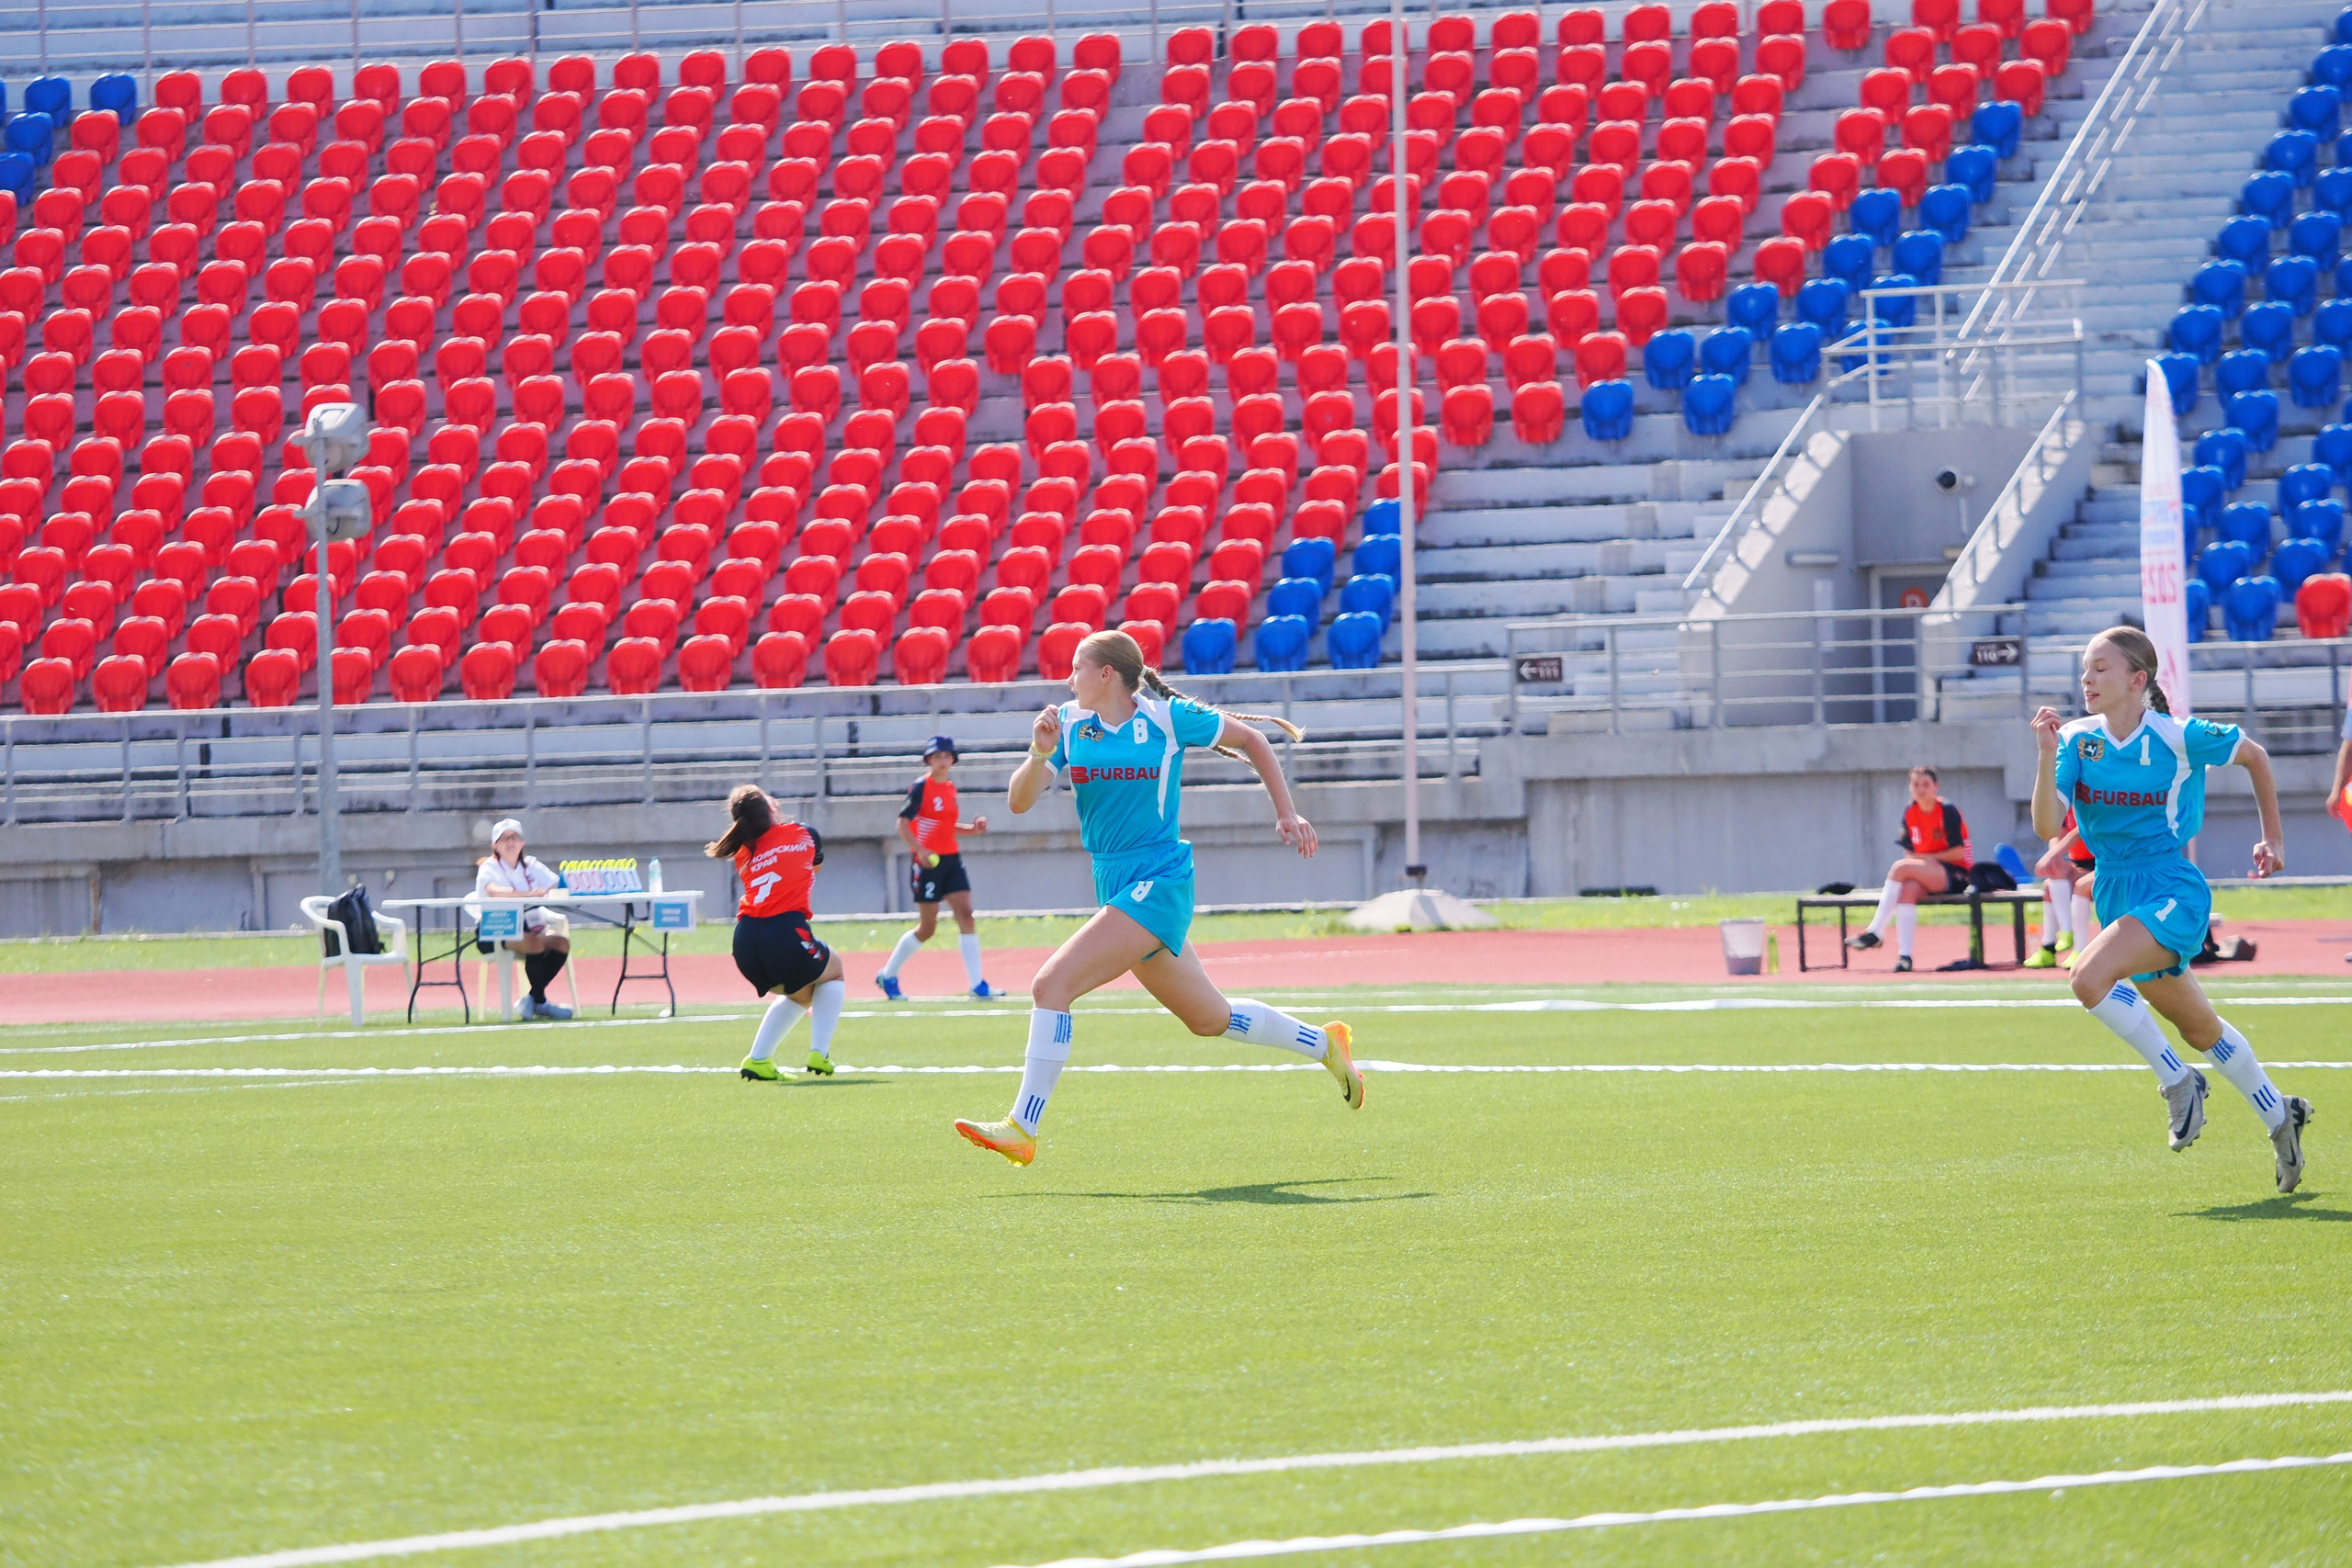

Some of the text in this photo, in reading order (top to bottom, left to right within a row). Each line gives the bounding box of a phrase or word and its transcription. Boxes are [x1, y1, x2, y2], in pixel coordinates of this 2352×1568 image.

[1132, 717, 1148, 745] 8
[2139, 734, 2151, 766] 1
[1090, 766, 1160, 781] FURBAU
[933, 795, 944, 812] 2
[2092, 789, 2168, 807] FURBAU
[750, 871, 783, 906] 7
[924, 881, 936, 899] 2
[1130, 880, 1154, 902] 8
[2154, 897, 2177, 922] 1
